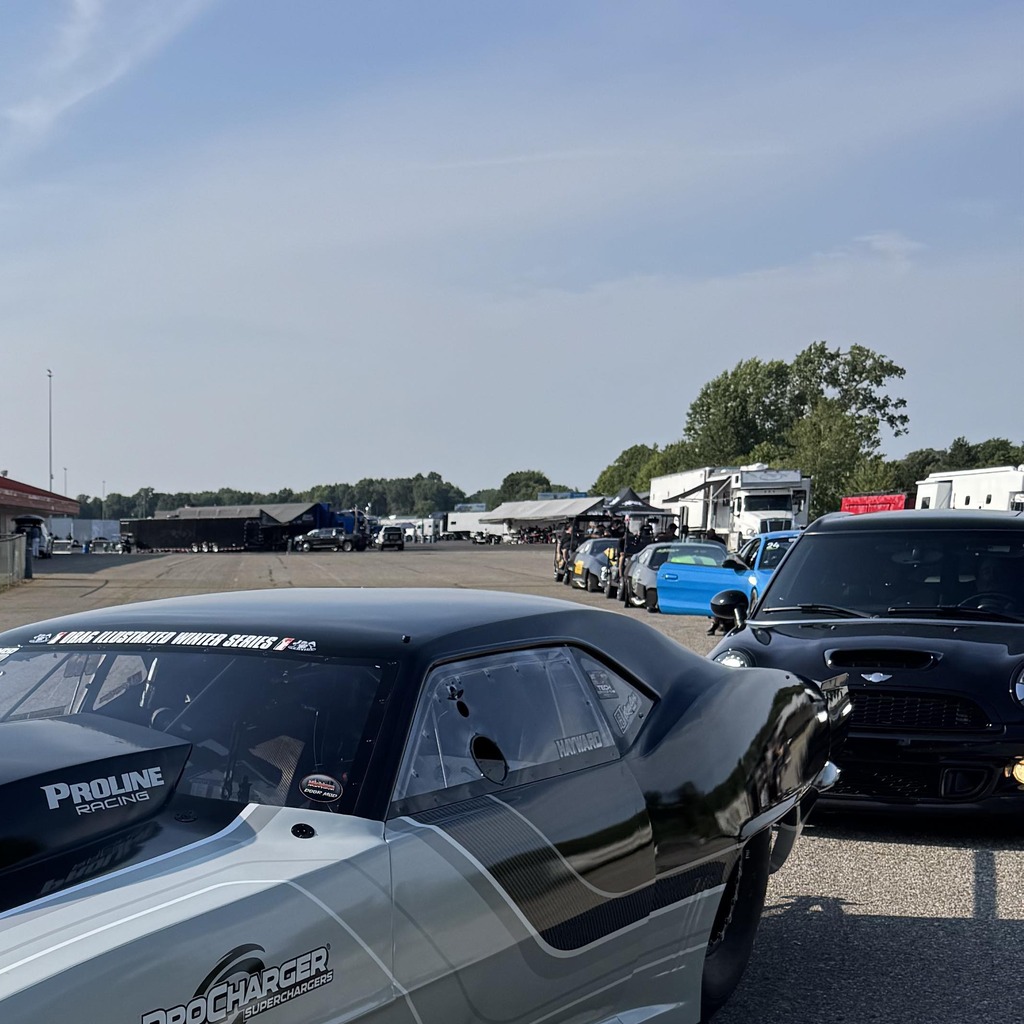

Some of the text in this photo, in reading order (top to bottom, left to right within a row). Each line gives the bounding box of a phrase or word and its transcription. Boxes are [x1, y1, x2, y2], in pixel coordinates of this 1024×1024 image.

[59, 630, 278, 650] DRAG ILLUSTRATED WINTER SERIES
[555, 730, 603, 758] HAYWARD
[40, 766, 165, 810] PROLINE
[75, 790, 150, 816] RACING
[243, 970, 334, 1021] SUPERCHARGERS
